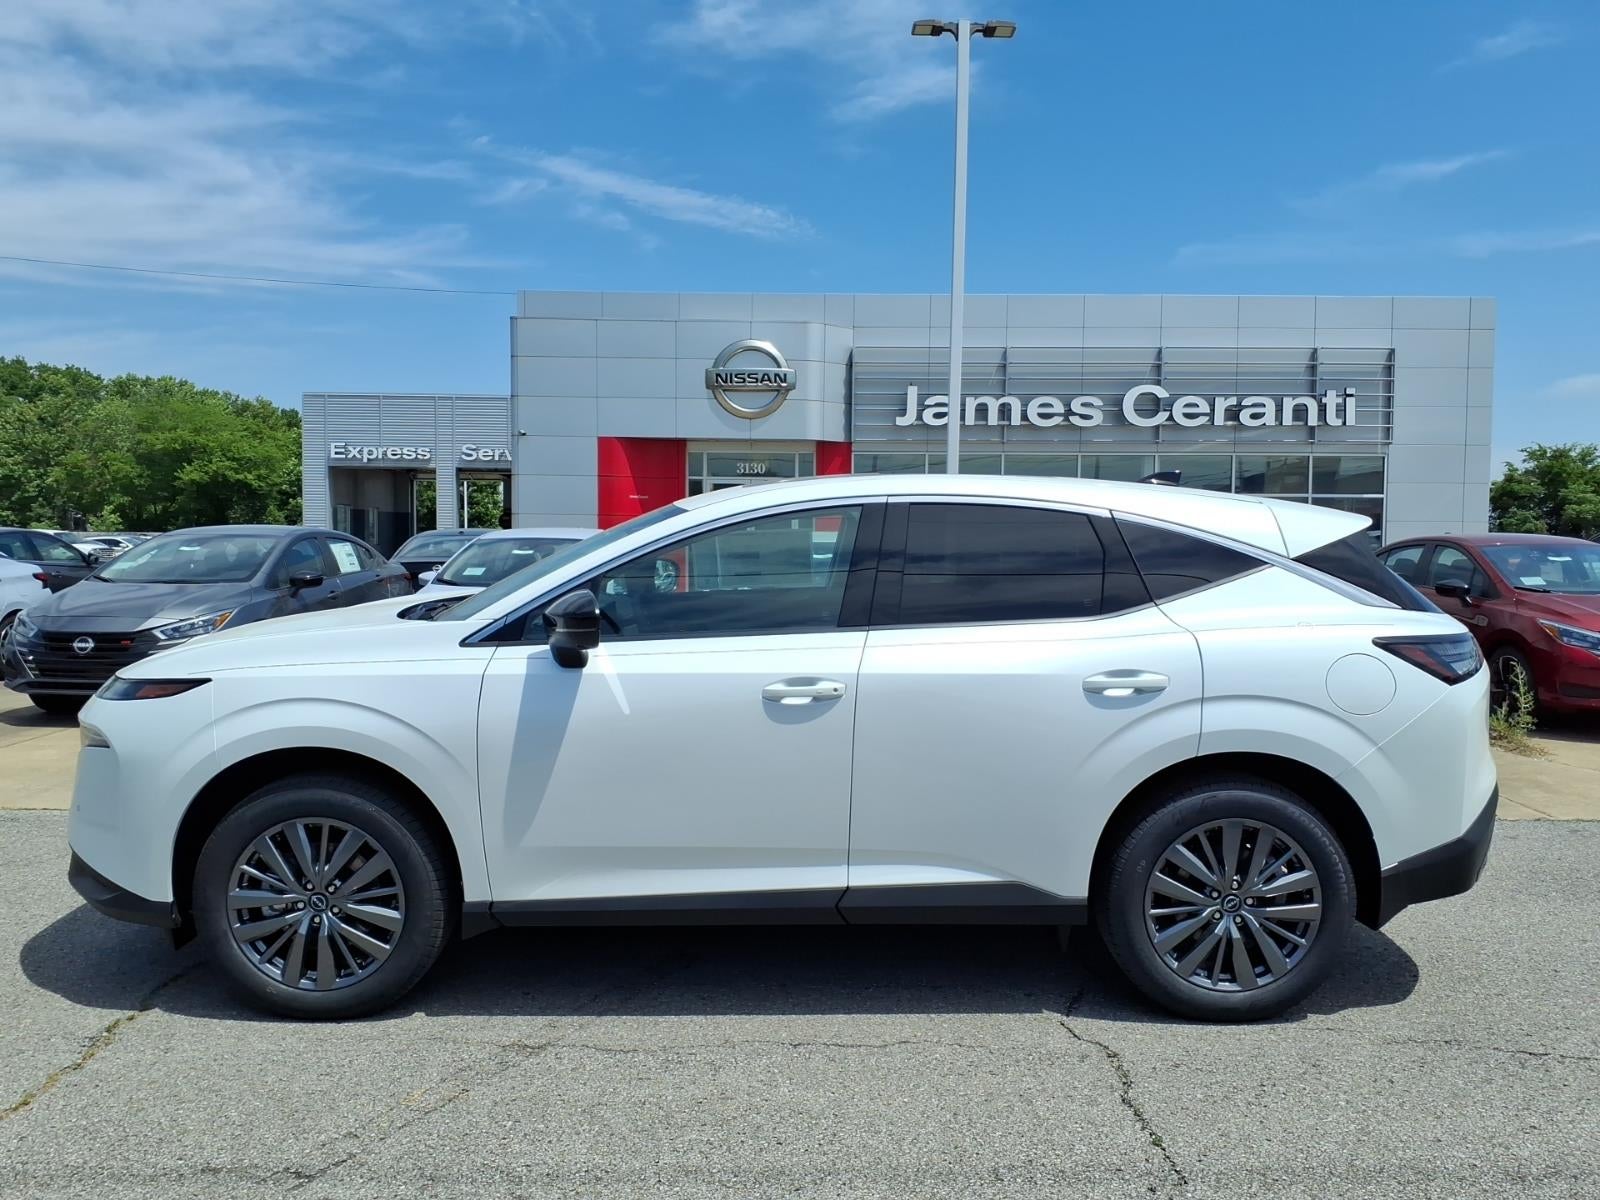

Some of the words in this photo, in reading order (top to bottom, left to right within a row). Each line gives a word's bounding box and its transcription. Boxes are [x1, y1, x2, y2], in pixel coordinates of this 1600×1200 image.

[715, 372, 788, 386] NISSAN
[895, 385, 1105, 427] James
[1122, 384, 1356, 427] Ceranti
[330, 442, 432, 463] Express
[736, 462, 766, 474] 3130
